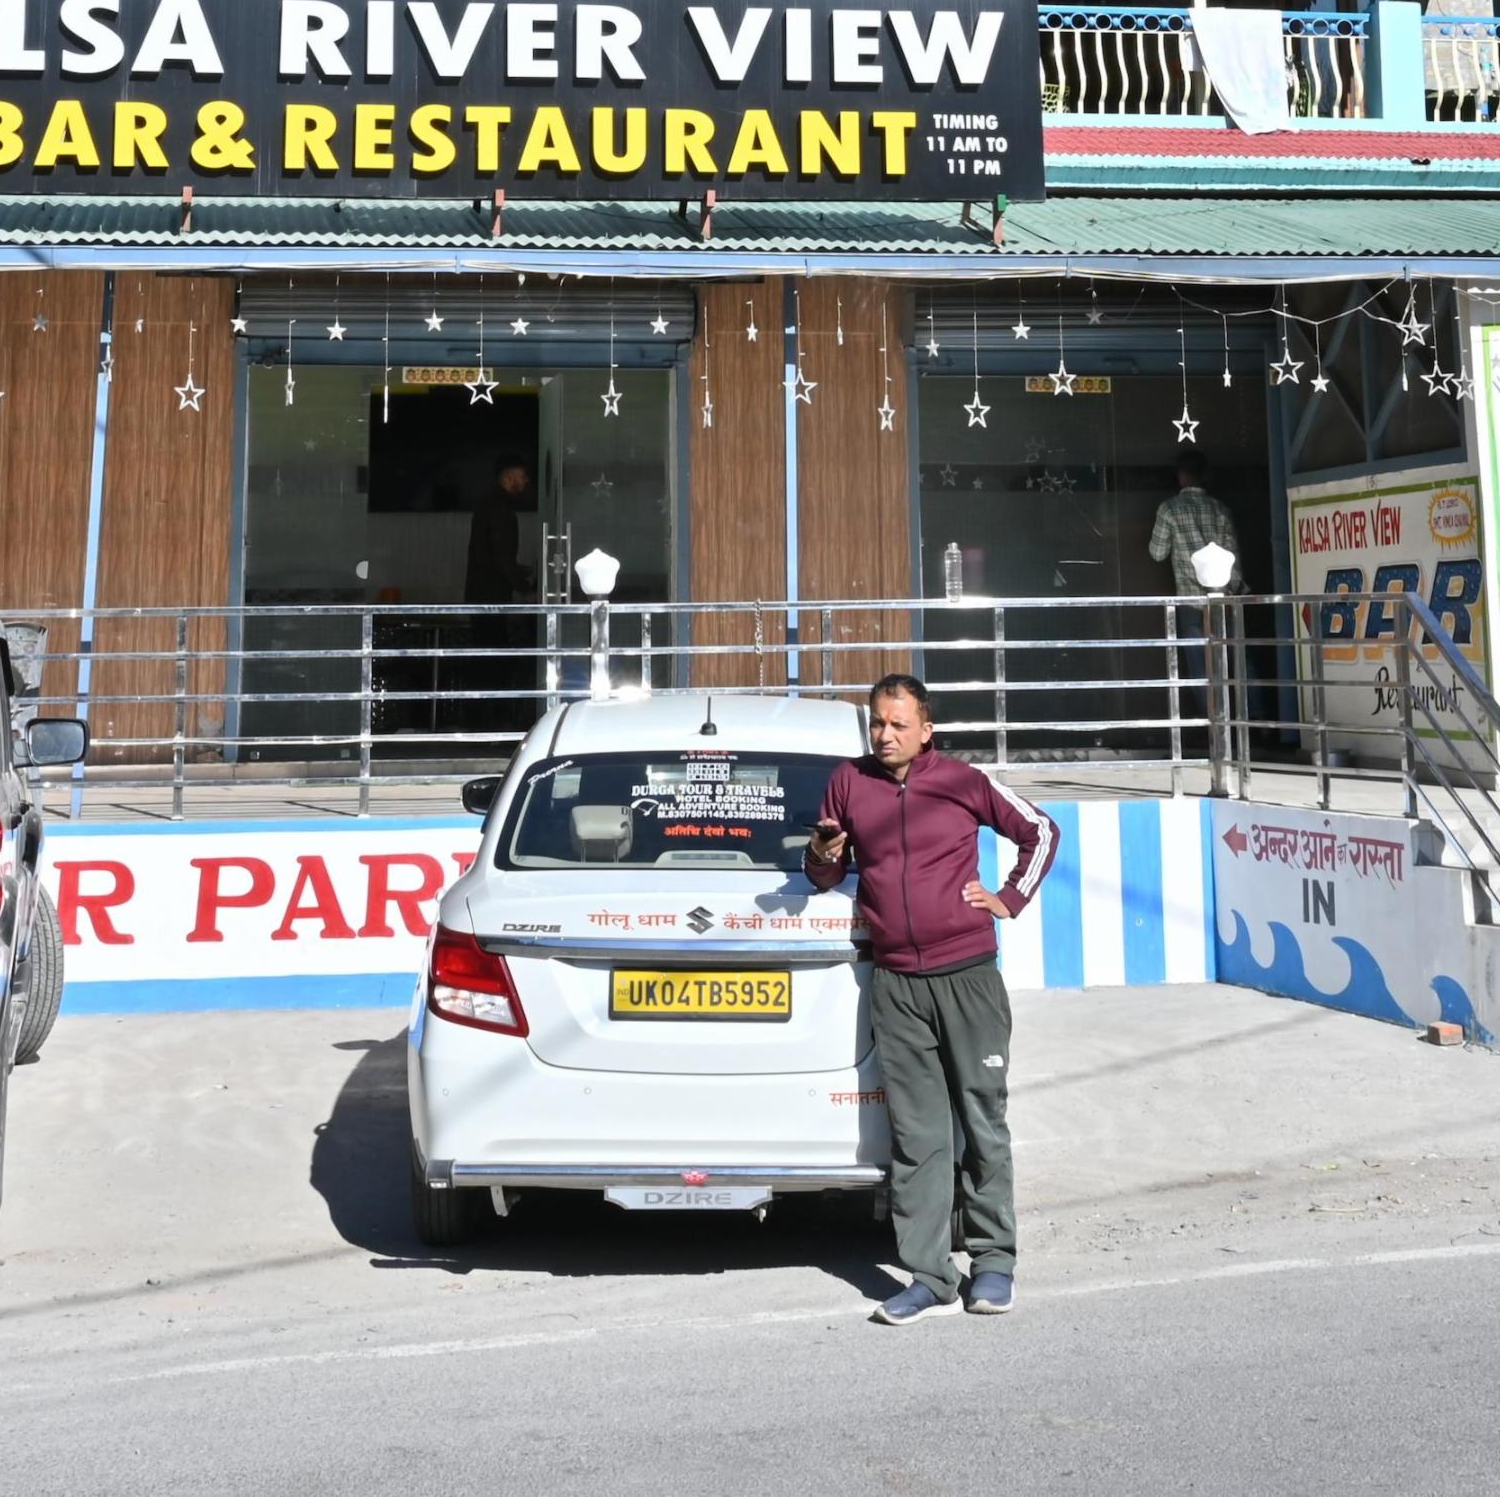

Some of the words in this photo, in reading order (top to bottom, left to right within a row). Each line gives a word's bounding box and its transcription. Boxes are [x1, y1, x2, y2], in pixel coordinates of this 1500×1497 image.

[279, 0, 646, 80] RIVER
[686, 6, 1004, 85] VIEW
[932, 114, 999, 131] TIMING
[189, 100, 257, 172] &
[284, 102, 917, 176] RESTAURANT
[926, 136, 945, 152] 11
[952, 136, 981, 152] AM
[986, 136, 1008, 153] TO
[947, 159, 965, 174] 11
[973, 159, 1001, 175] PM
[1297, 515, 1331, 554] KALSA
[1332, 509, 1368, 551] RIVER
[1370, 499, 1402, 546] VIEW
[1319, 557, 1485, 648] BAR
[631, 784, 676, 796] DURGA
[678, 784, 713, 795] TOUR
[725, 784, 785, 798] TRAVELS
[675, 795, 712, 803] HOTEL
[715, 795, 766, 804] BOOKING
[658, 802, 676, 811] ALL
[678, 802, 737, 811] ADVENTURE
[739, 803, 785, 813] BOOKING
[186, 852, 477, 943] PAR
[1302, 877, 1336, 927] IN
[502, 923, 562, 933] DZIRE
[587, 909, 634, 930] गोलू
[637, 913, 678, 927] धाम
[722, 911, 765, 930] कैंची
[629, 979, 787, 1007] UK04TB5952
[643, 1191, 732, 1205] DZIRE
